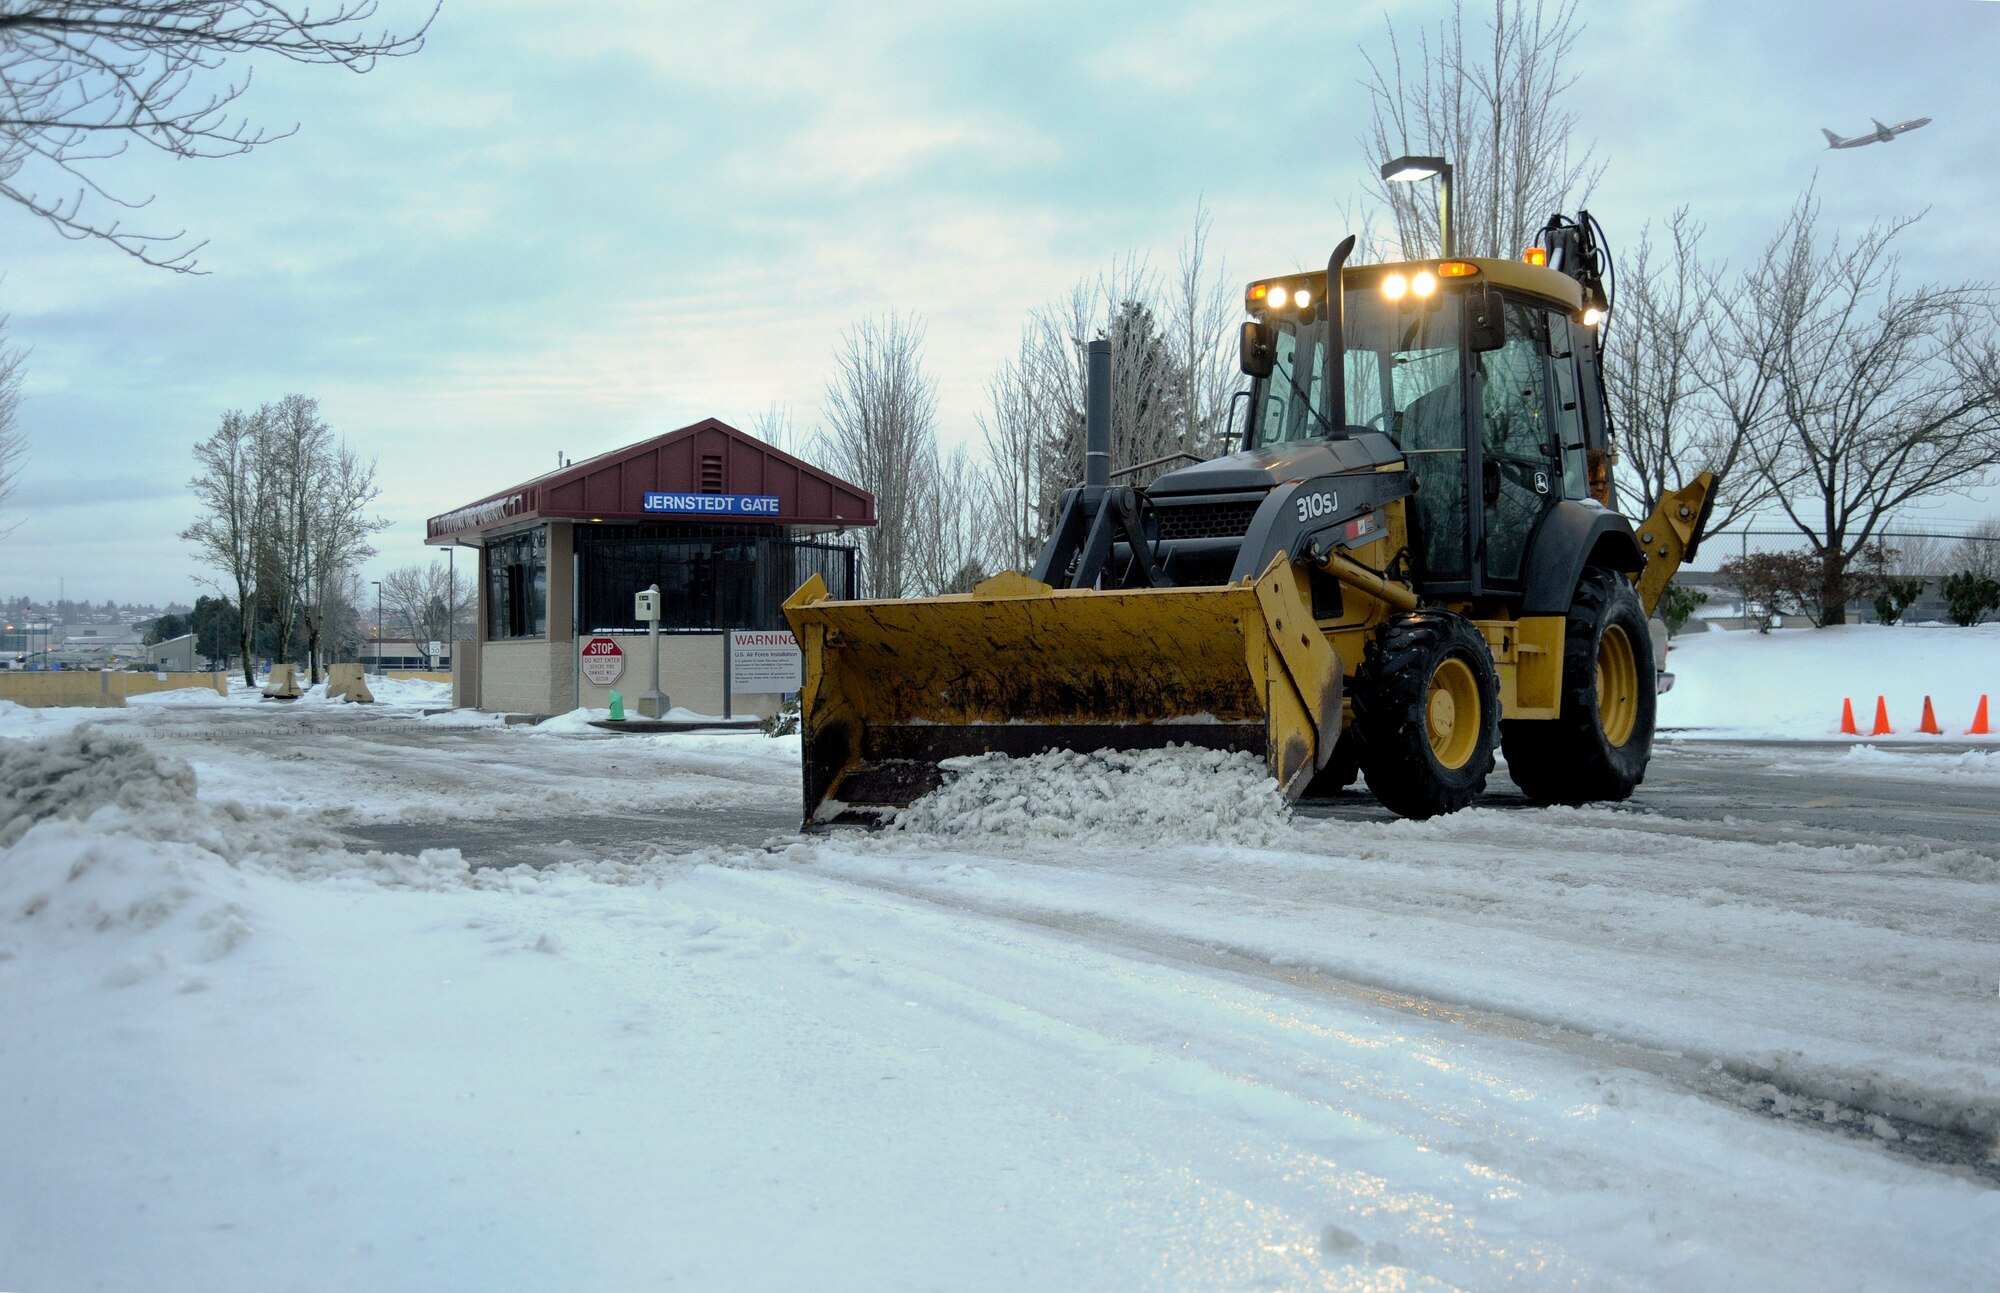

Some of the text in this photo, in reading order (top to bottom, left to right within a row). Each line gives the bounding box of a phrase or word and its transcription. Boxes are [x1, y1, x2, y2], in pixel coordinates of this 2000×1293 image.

[644, 496, 779, 512] JERNSTEDT GATE
[1296, 491, 1338, 522] 310SJ
[735, 634, 797, 646] WARNING
[591, 642, 614, 655] STOP
